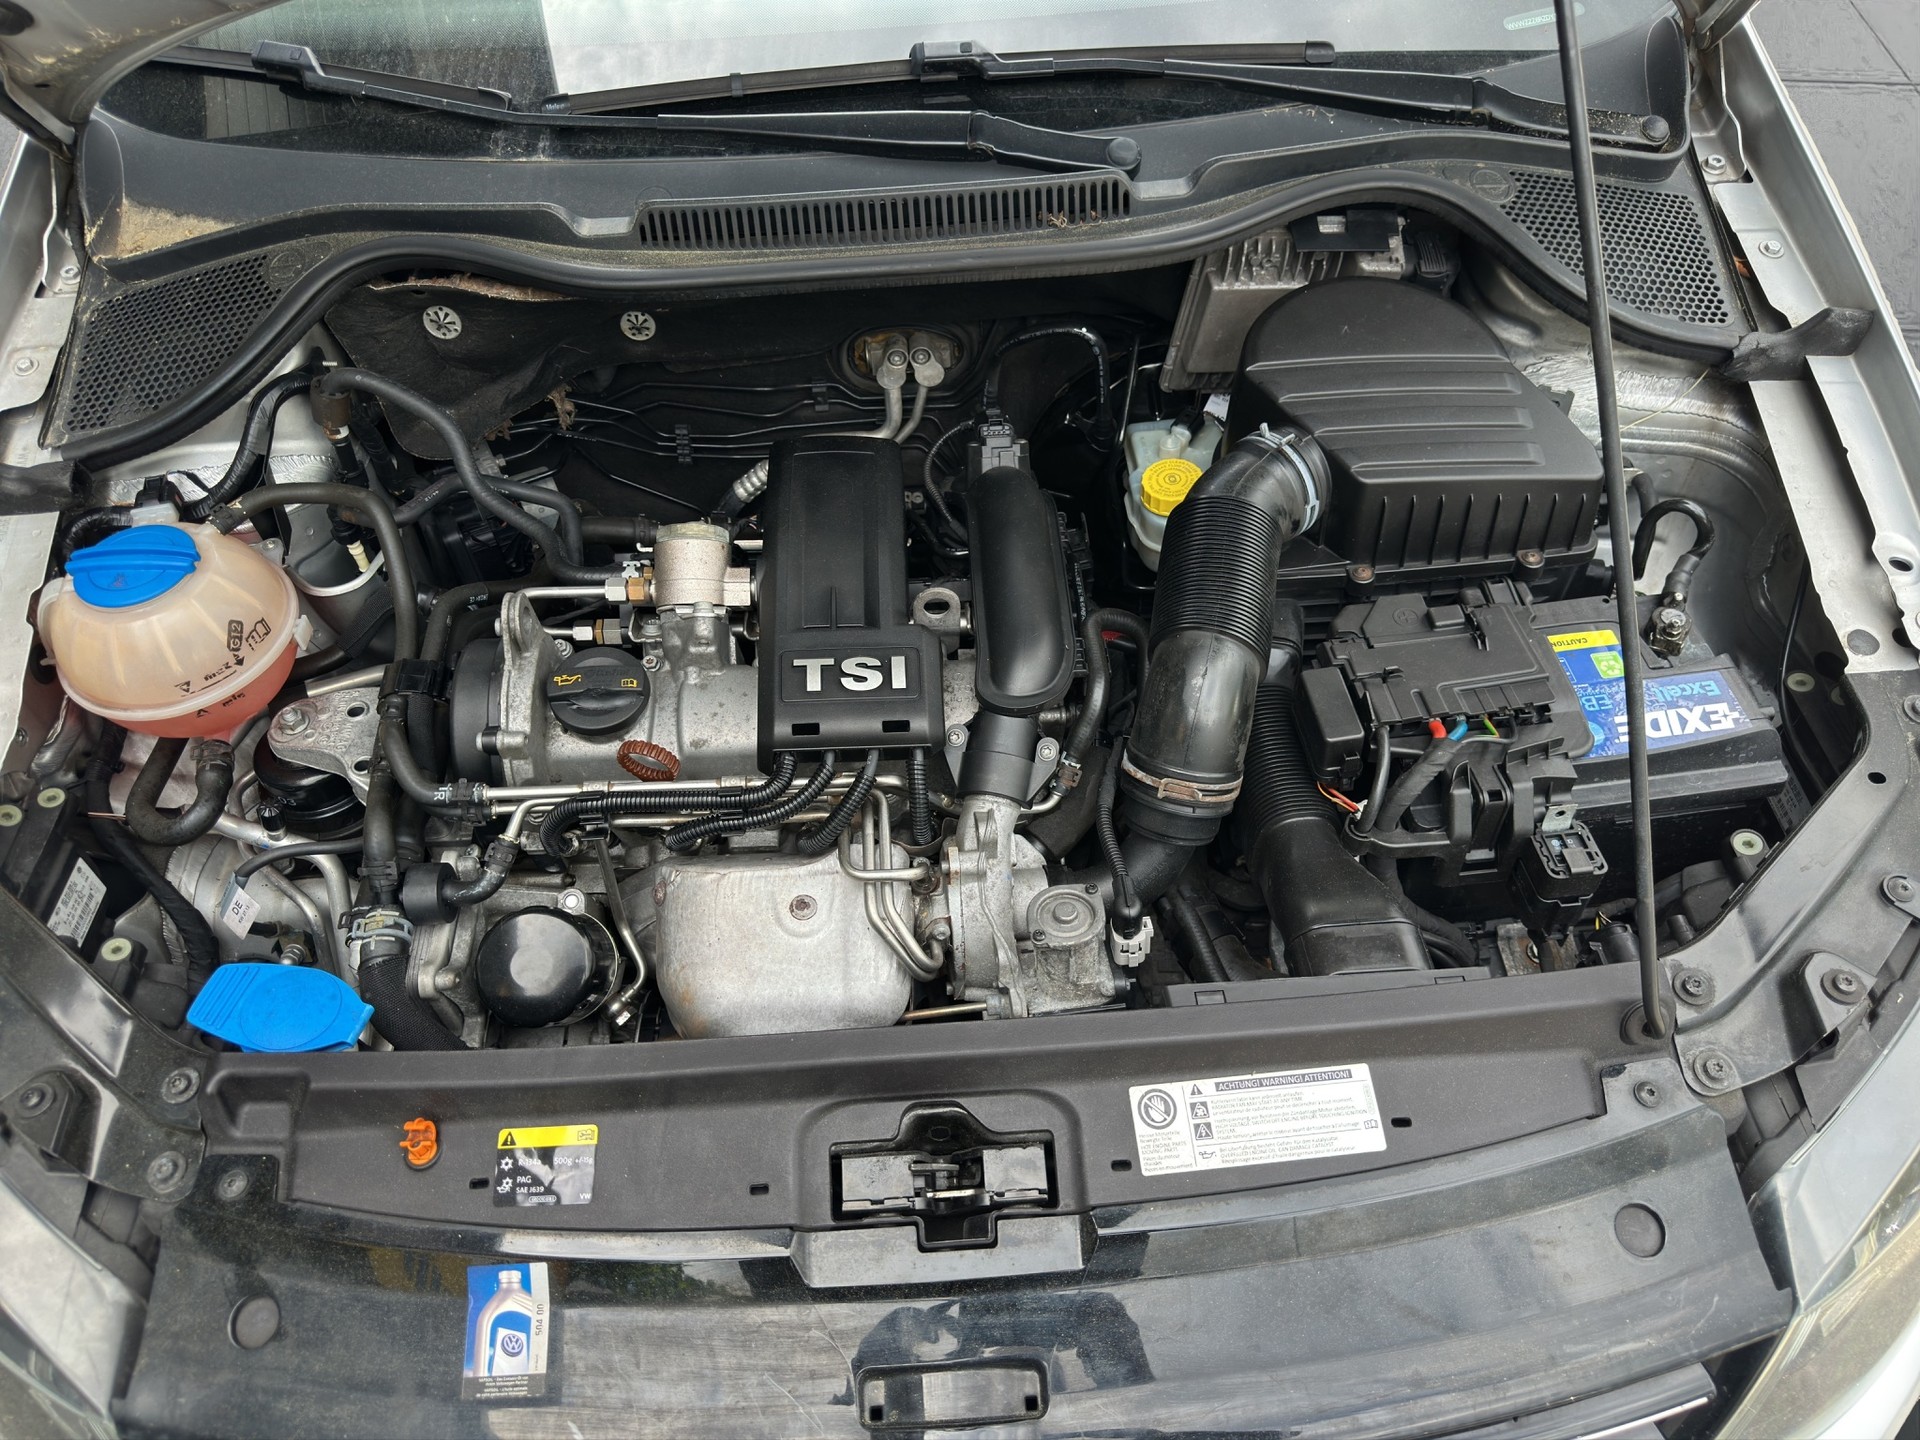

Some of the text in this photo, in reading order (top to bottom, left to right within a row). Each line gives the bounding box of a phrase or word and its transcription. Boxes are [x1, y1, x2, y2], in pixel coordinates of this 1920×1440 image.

[793, 656, 907, 692] TSI
[1613, 702, 1740, 744] EXIDE
[231, 900, 243, 915] DE
[1217, 1069, 1350, 1091] ACHTUNG! WARNING! ATTENTION!
[516, 1186, 528, 1194] SAE
[517, 1176, 532, 1184] PAG
[535, 1303, 544, 1336] 504 00
